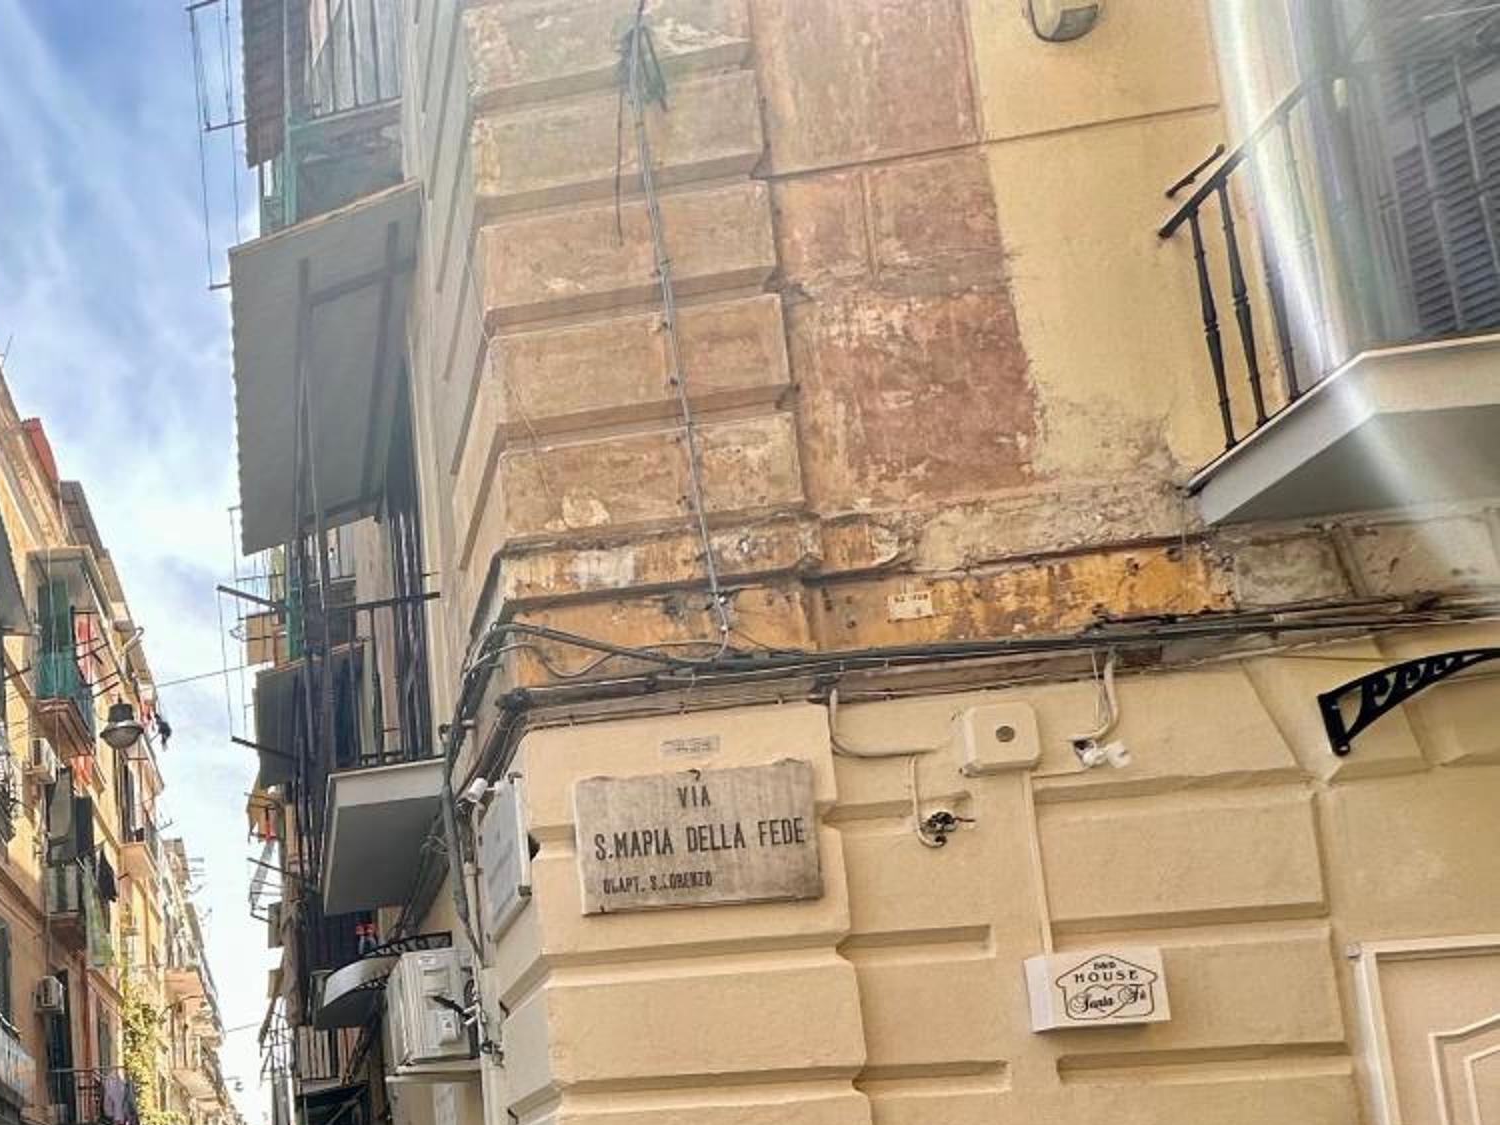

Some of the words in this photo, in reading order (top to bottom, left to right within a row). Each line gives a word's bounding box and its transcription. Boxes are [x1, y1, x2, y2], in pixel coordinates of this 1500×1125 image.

[676, 786, 711, 808] VIA
[686, 822, 746, 852] DELLA
[757, 817, 805, 846] FEDE
[1074, 970, 1139, 983] HOUSE
